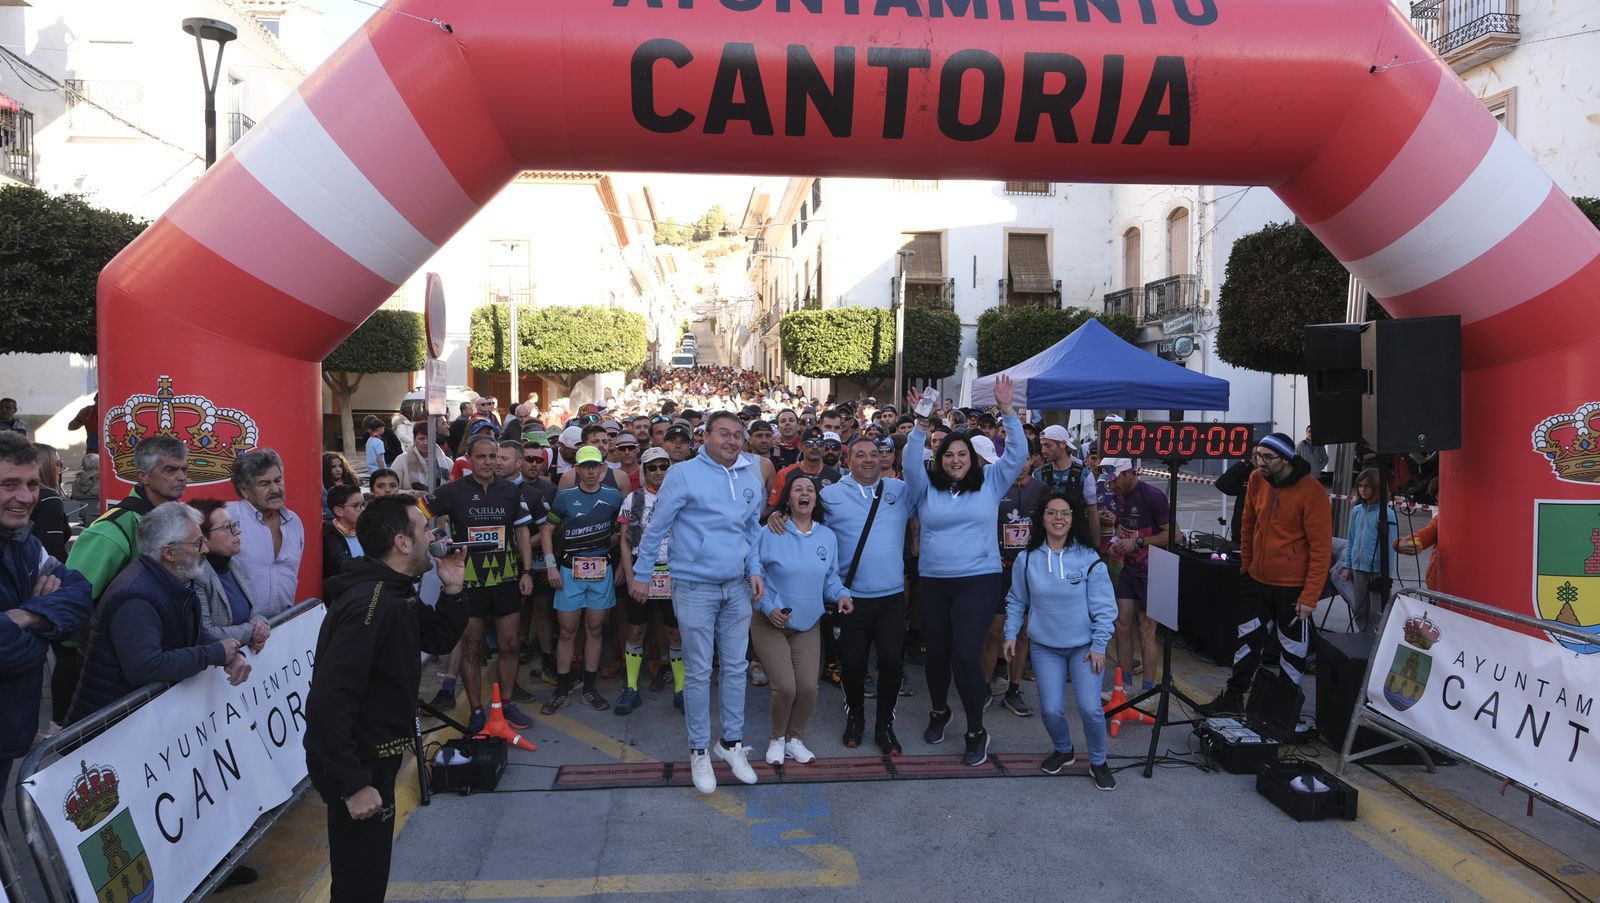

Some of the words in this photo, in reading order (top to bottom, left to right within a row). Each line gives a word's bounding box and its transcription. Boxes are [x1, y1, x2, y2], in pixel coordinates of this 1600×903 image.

[630, 38, 1191, 146] CANTORIA
[1103, 424, 1249, 456] 00:00:00
[475, 532, 498, 541] 208
[1013, 529, 1027, 537] 77
[582, 562, 596, 570] 31
[155, 680, 313, 844] CANTOR
